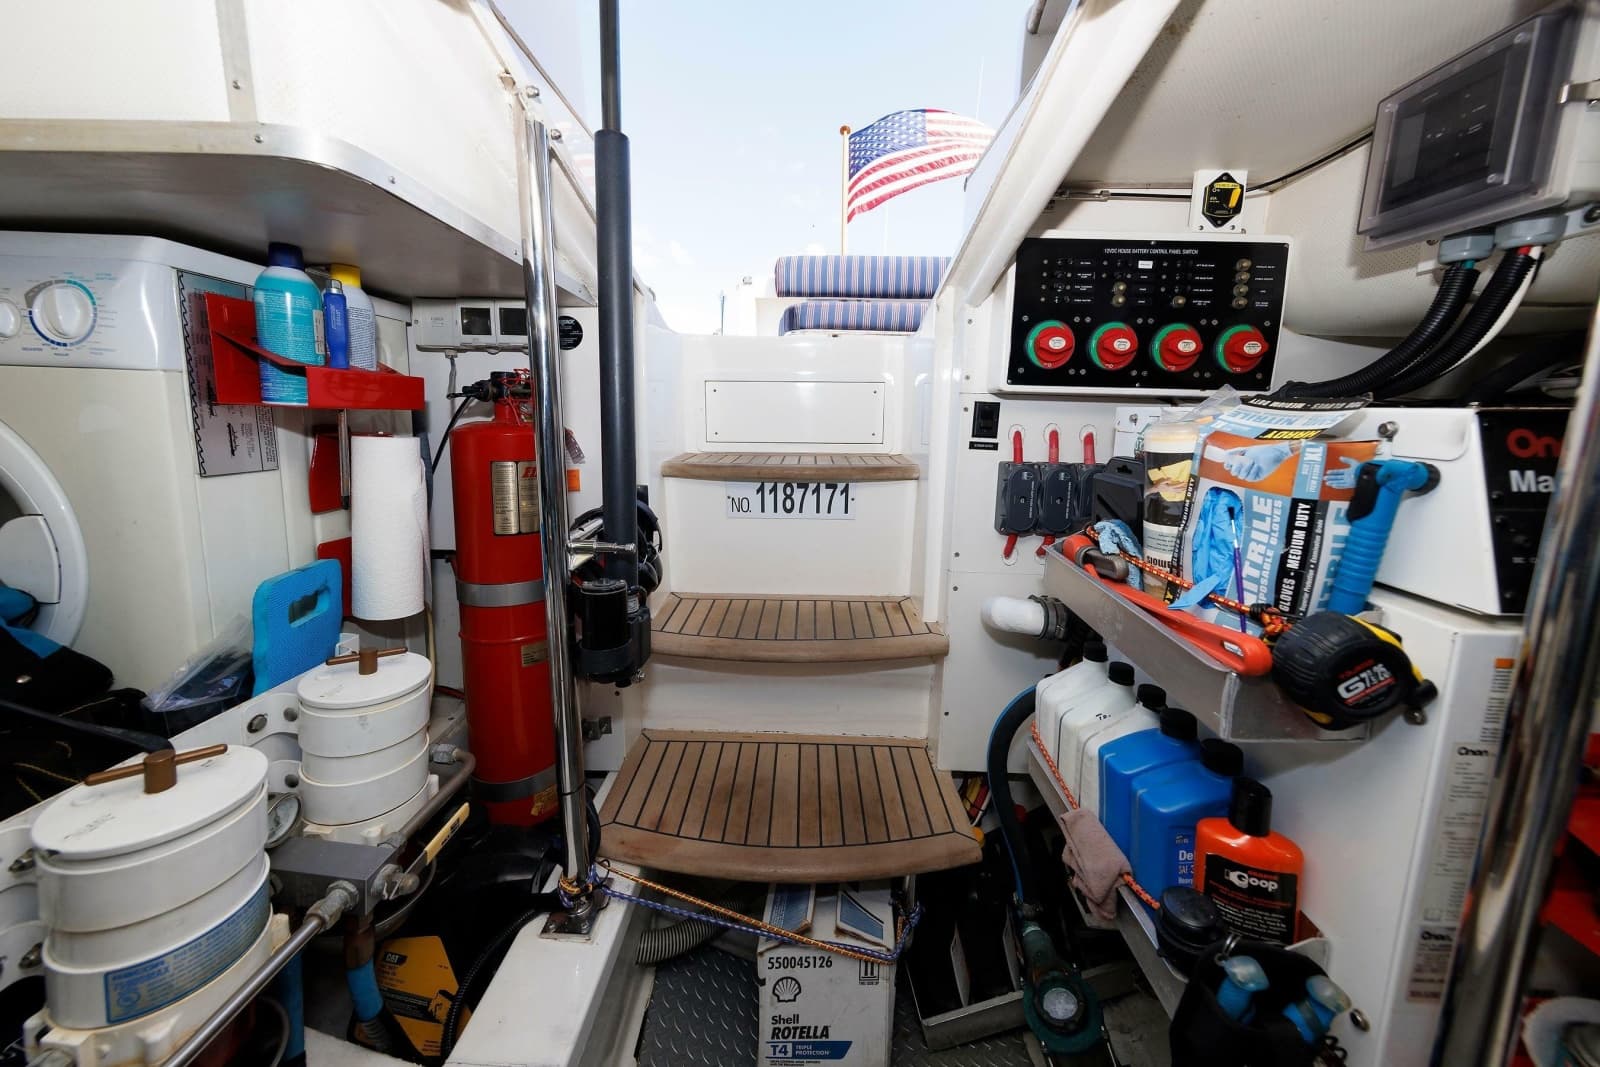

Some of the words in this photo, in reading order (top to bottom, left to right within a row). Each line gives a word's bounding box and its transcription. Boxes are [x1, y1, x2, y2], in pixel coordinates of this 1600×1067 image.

[1263, 430, 1321, 440] HARDY
[1304, 447, 1323, 463] XL
[1186, 477, 1196, 497] DUTY
[731, 497, 752, 513] NO.
[756, 481, 850, 515] 1187171
[1269, 499, 1283, 546] GLOVES
[1294, 503, 1312, 528] DUTY
[1286, 529, 1307, 570] MEDIUM
[1279, 578, 1296, 612] GLOVES
[1232, 870, 1279, 893] Goop
[386, 953, 400, 964] CAT
[767, 955, 833, 970] 550045126
[771, 1013, 800, 1026] Shell
[770, 1025, 830, 1040] ROTELLA
[769, 1044, 789, 1056] T4
